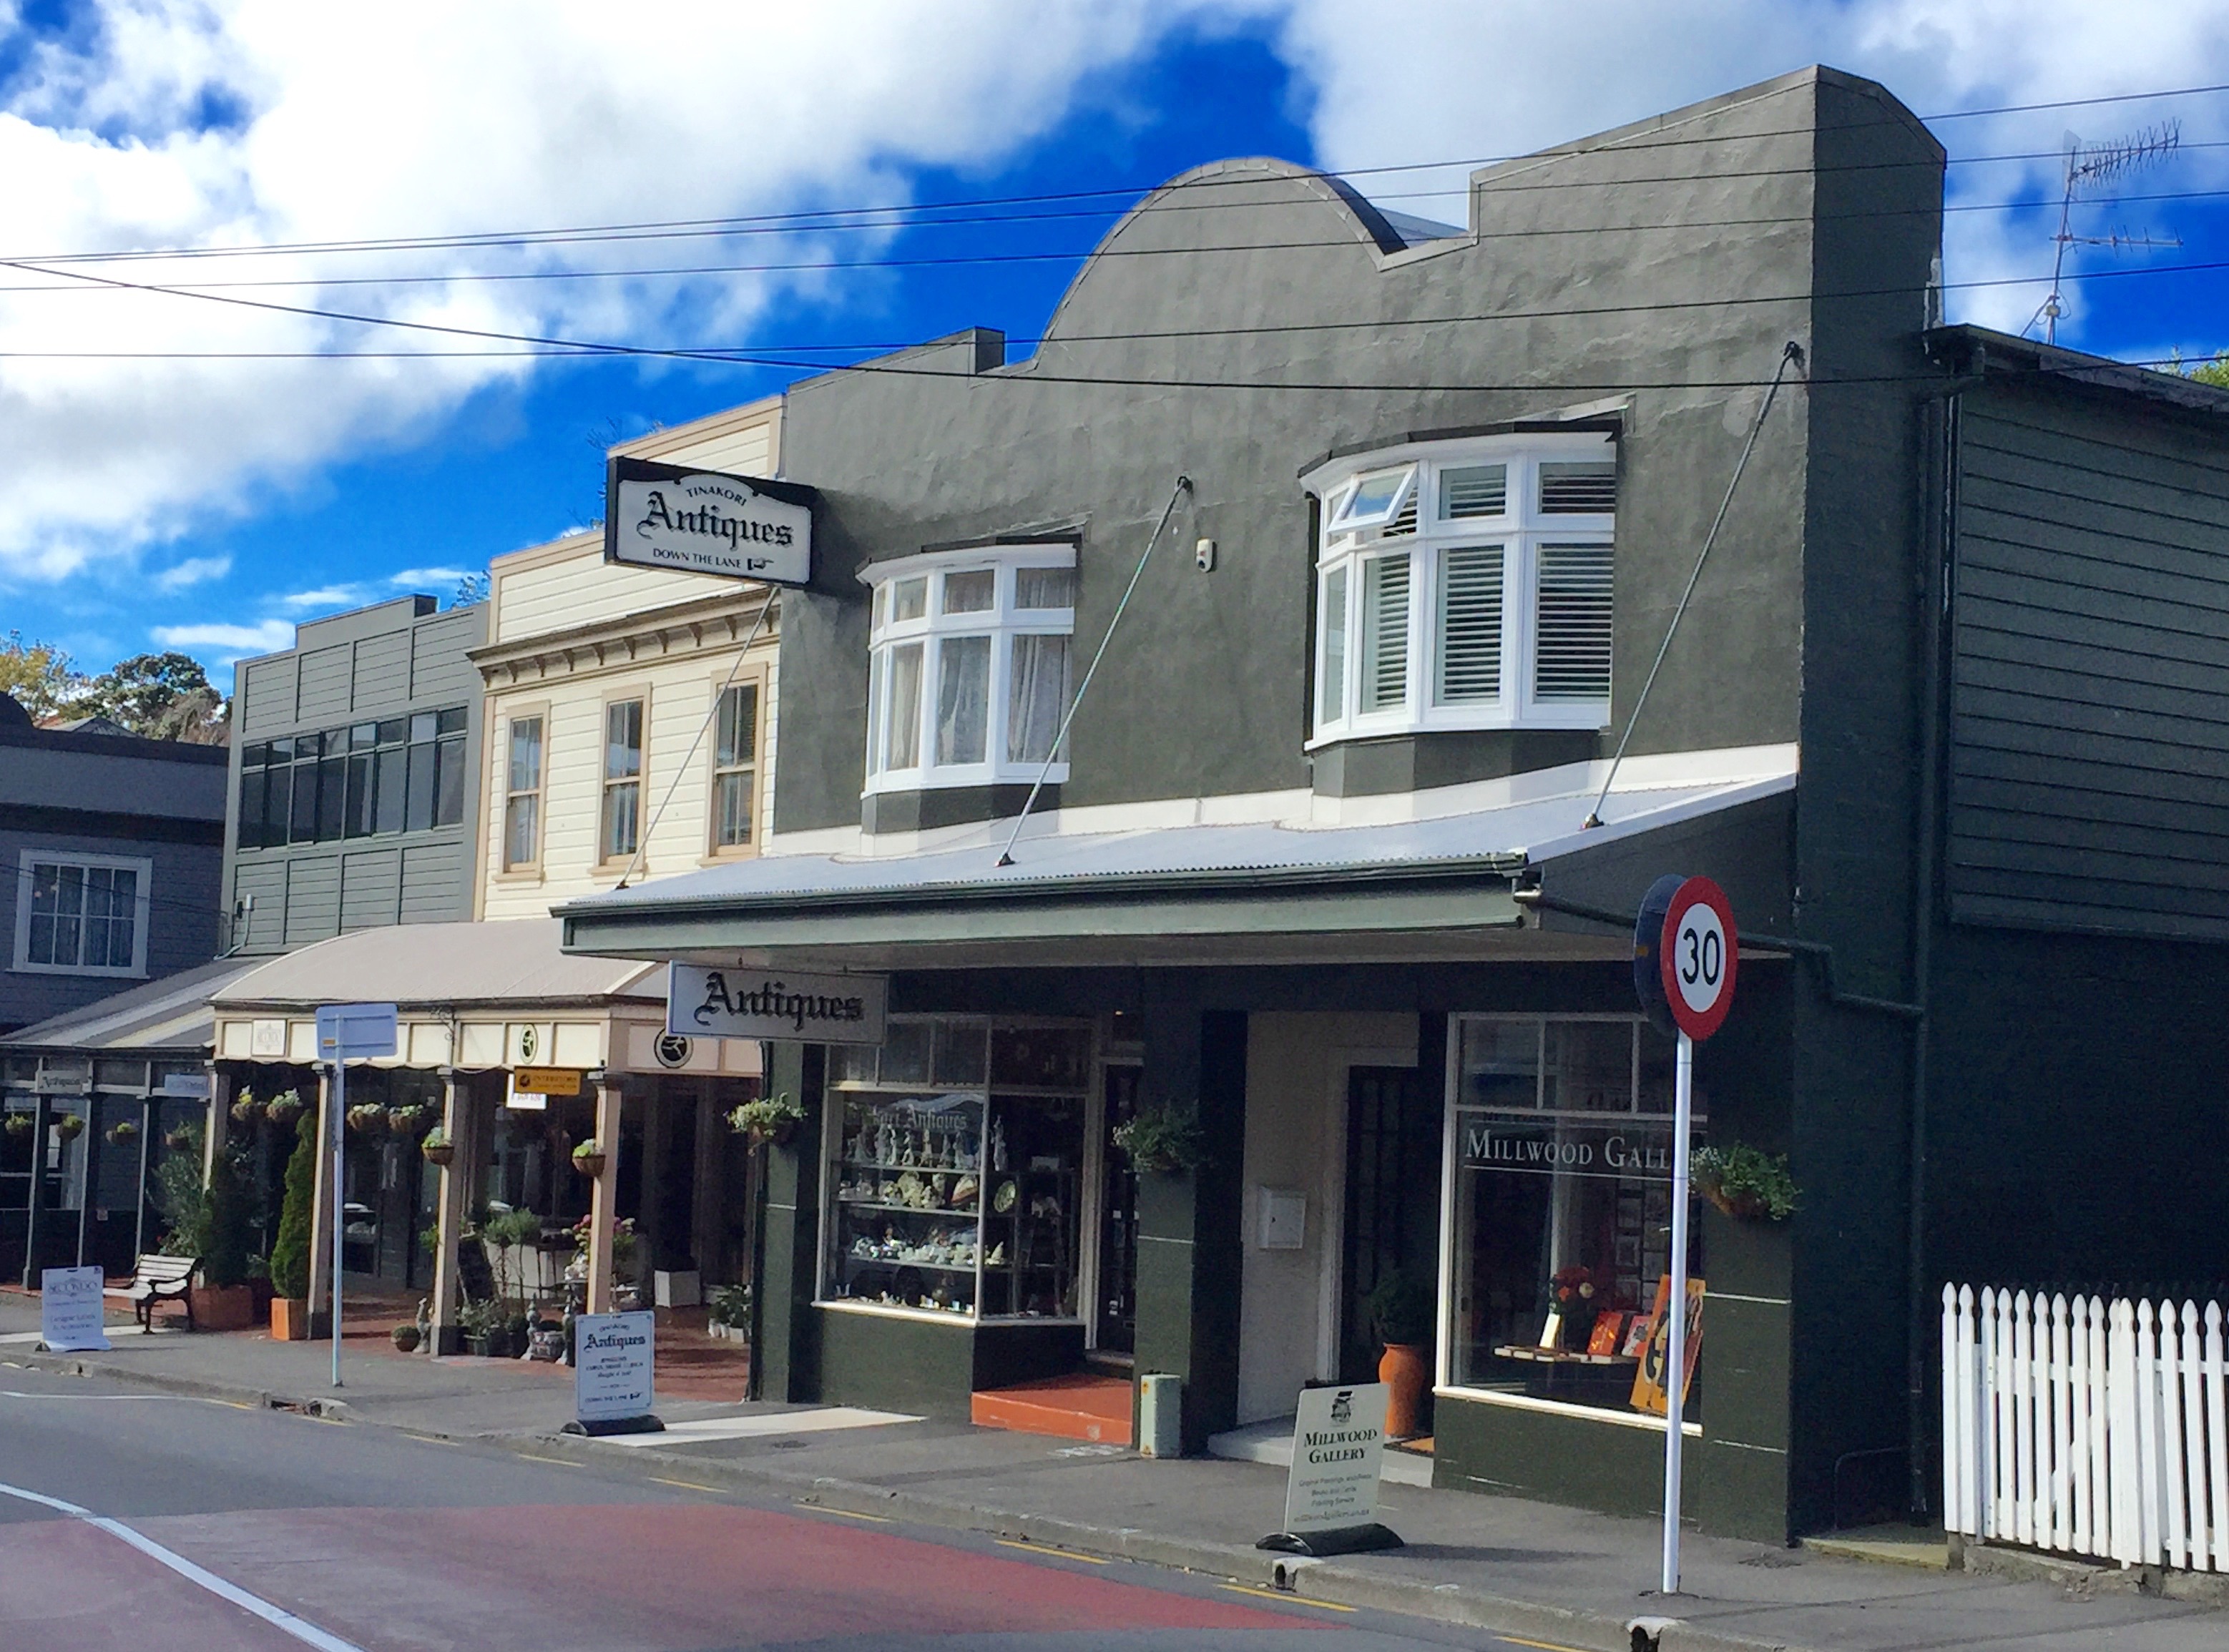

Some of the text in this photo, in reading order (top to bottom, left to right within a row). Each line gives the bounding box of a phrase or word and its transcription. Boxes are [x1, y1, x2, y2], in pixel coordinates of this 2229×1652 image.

[685, 486, 748, 506] TINAKORI
[636, 491, 794, 551] Antiques
[652, 548, 742, 569] DOWN THE LANE
[1682, 928, 1720, 986] 30
[693, 971, 865, 1032] Antiques
[1465, 1129, 1594, 1165] MILLWOOD
[583, 1333, 646, 1353] Antiques
[1304, 1428, 1377, 1447] MILLWOOD
[1308, 1447, 1367, 1464] GALLERY
